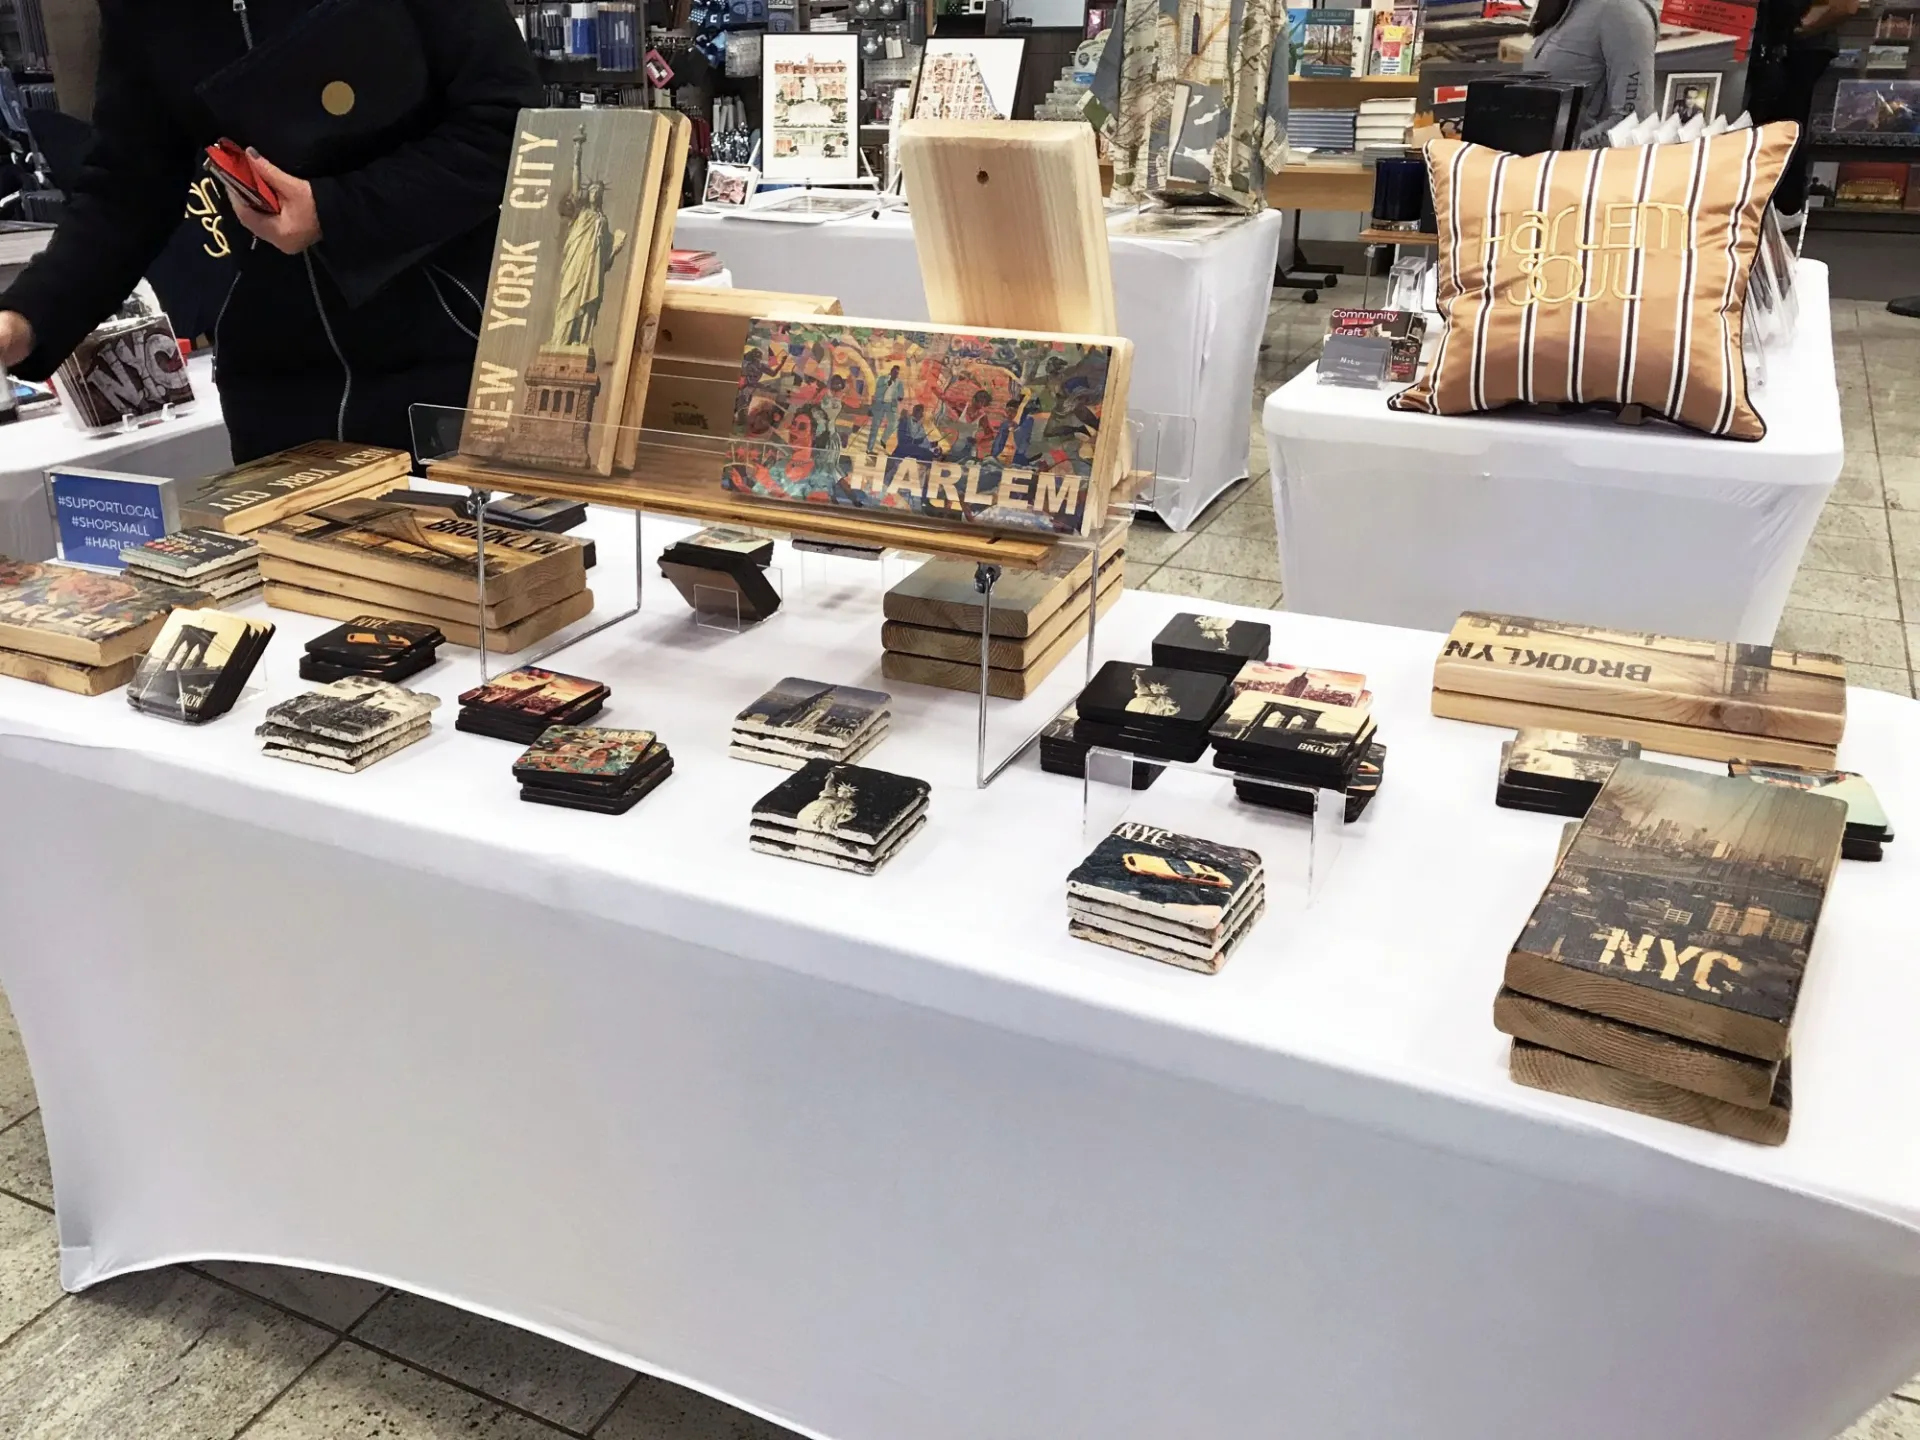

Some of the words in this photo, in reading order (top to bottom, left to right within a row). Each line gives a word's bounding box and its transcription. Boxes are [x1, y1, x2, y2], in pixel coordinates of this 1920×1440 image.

[508, 130, 559, 210] CITY
[487, 238, 541, 331] YORK
[469, 360, 519, 443] NEW
[336, 448, 393, 467] NEW
[267, 468, 341, 490] YORK
[849, 452, 1082, 516] HARLEM
[57, 495, 160, 520] #SUPPORTLOCAL
[208, 489, 272, 512] CITY
[71, 515, 151, 538] #SHOPSMALL
[423, 518, 571, 555] BROOKLYN
[84, 535, 137, 551] #HARLE
[0, 600, 135, 634] ARLEM
[1443, 638, 1653, 683] BROOKLYN
[1297, 742, 1338, 757] BKLYN
[1117, 821, 1174, 847] NYC
[1598, 927, 1744, 995] NYC
